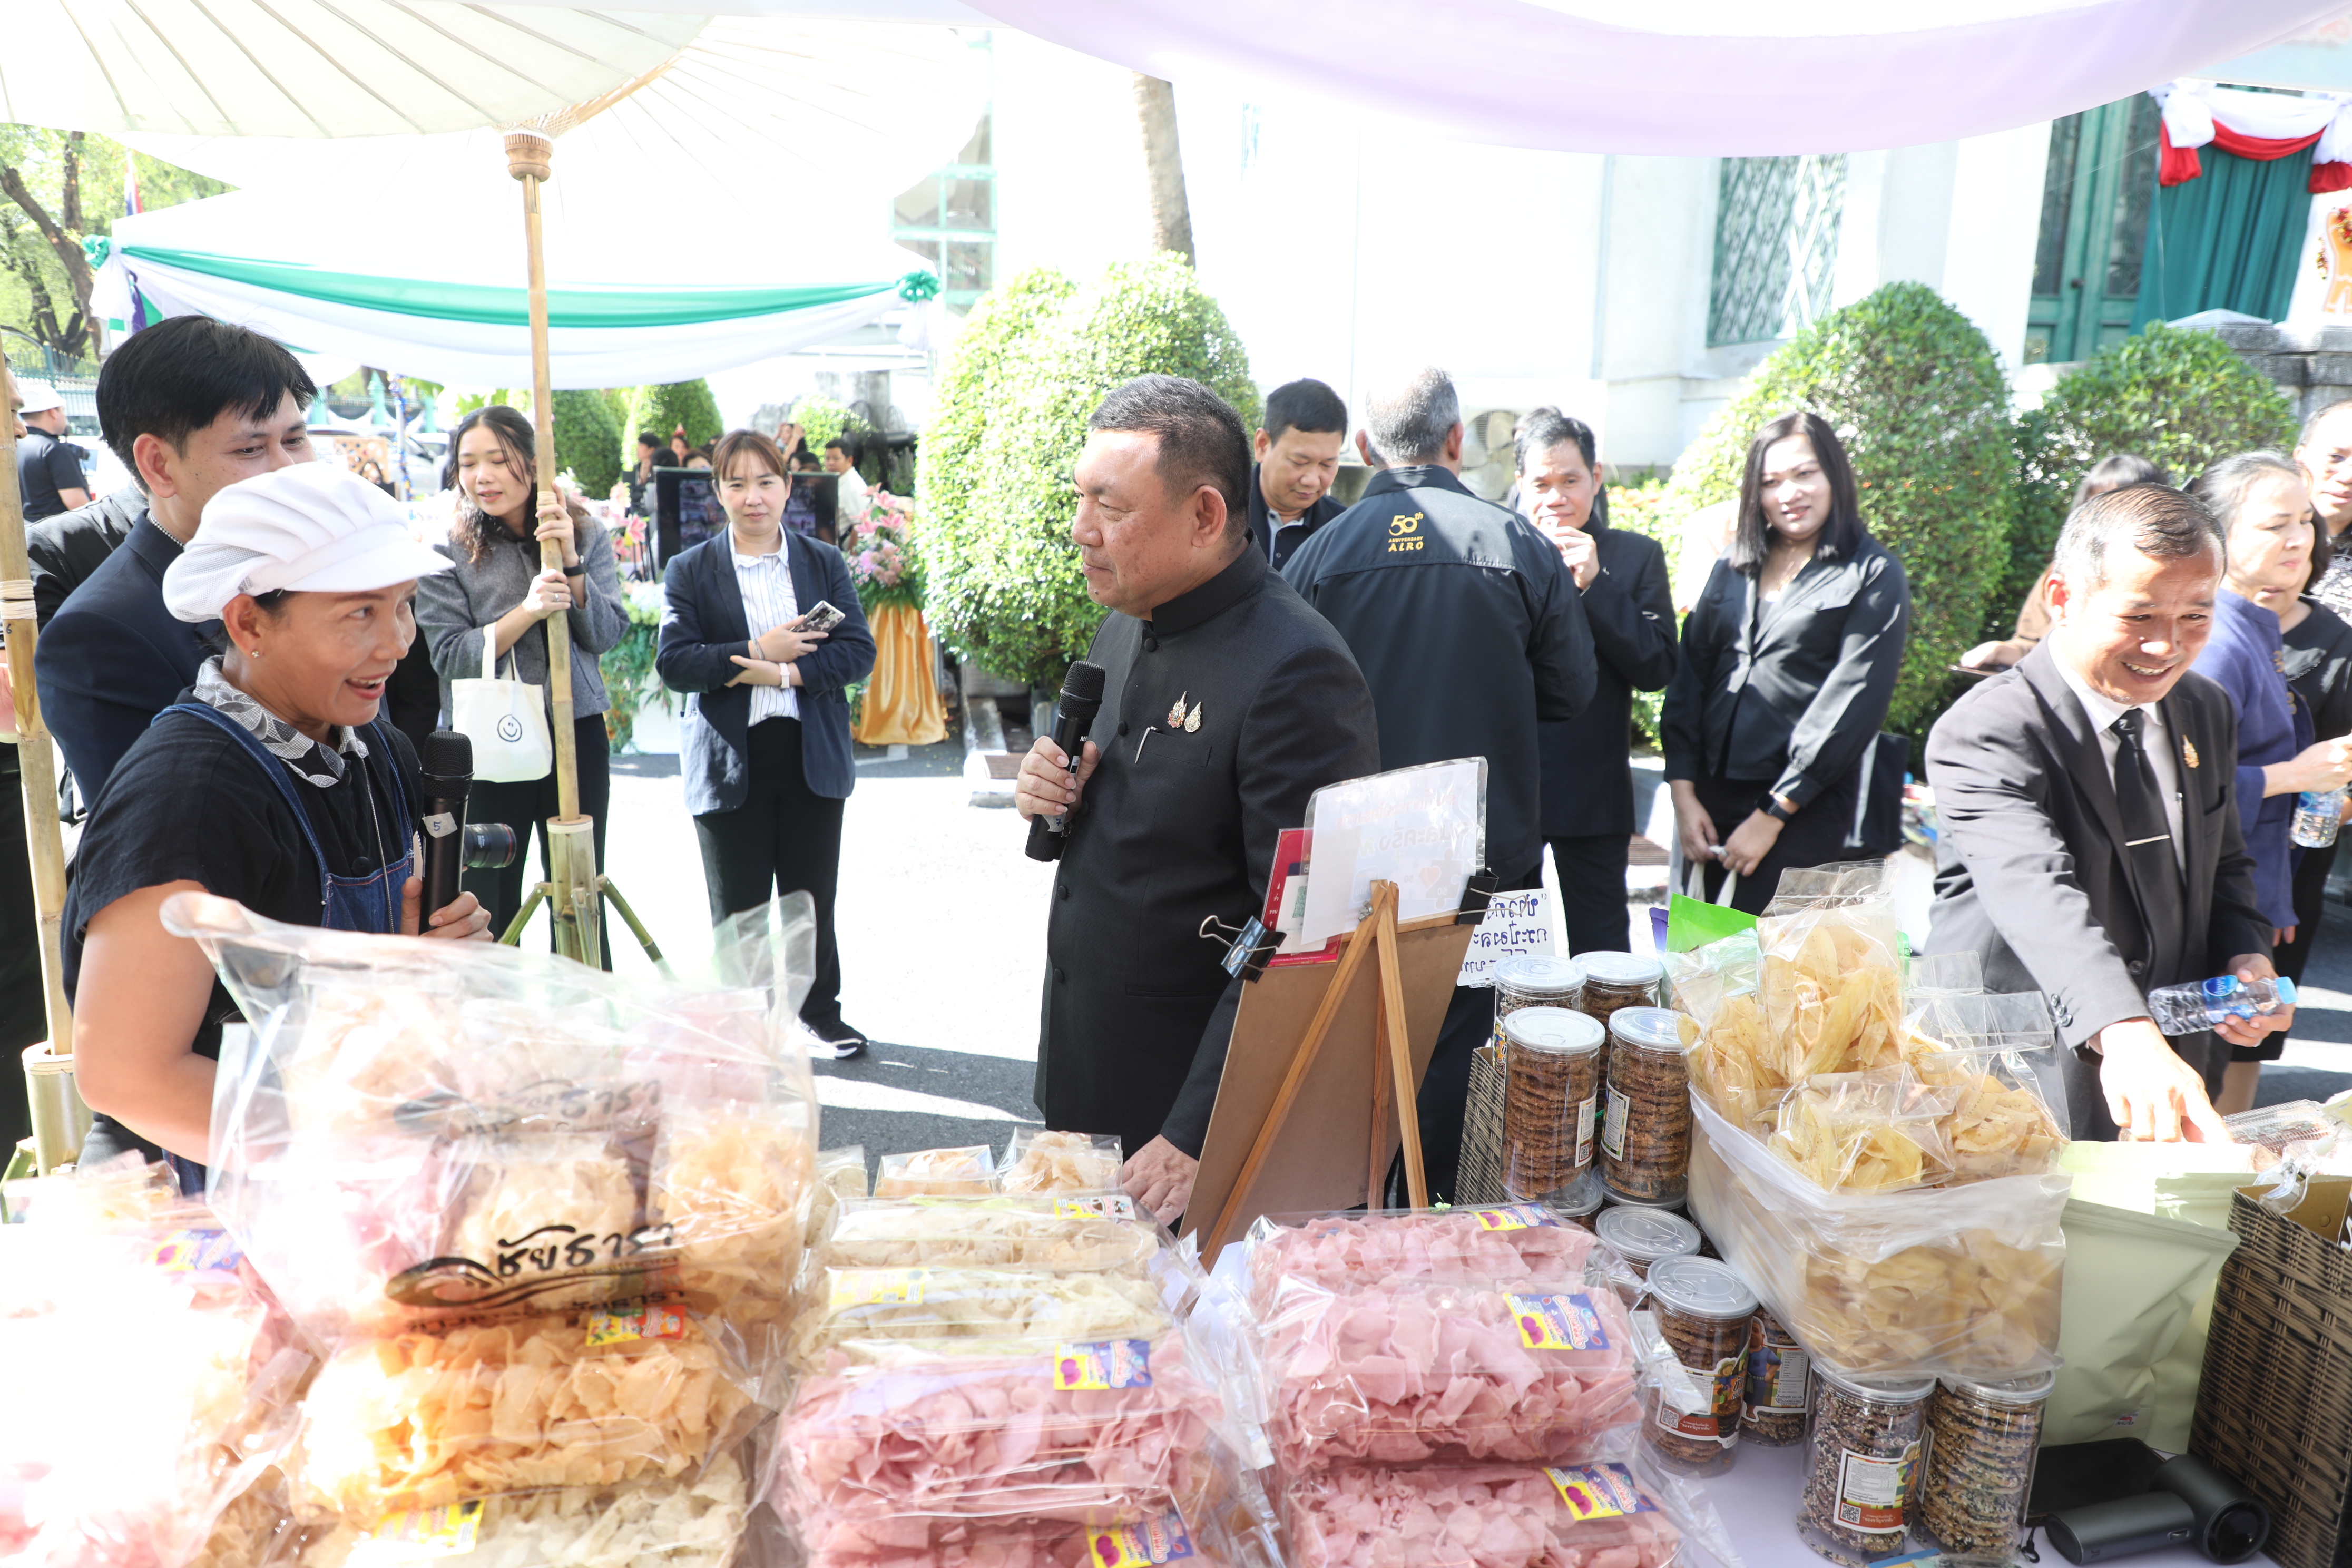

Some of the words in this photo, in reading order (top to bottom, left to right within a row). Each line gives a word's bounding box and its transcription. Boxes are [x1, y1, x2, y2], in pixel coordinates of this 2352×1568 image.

[1388, 512, 1425, 536] 50th
[1388, 541, 1425, 553] ALRO
[433, 820, 442, 832] 5
[1055, 818, 1062, 827] 7
